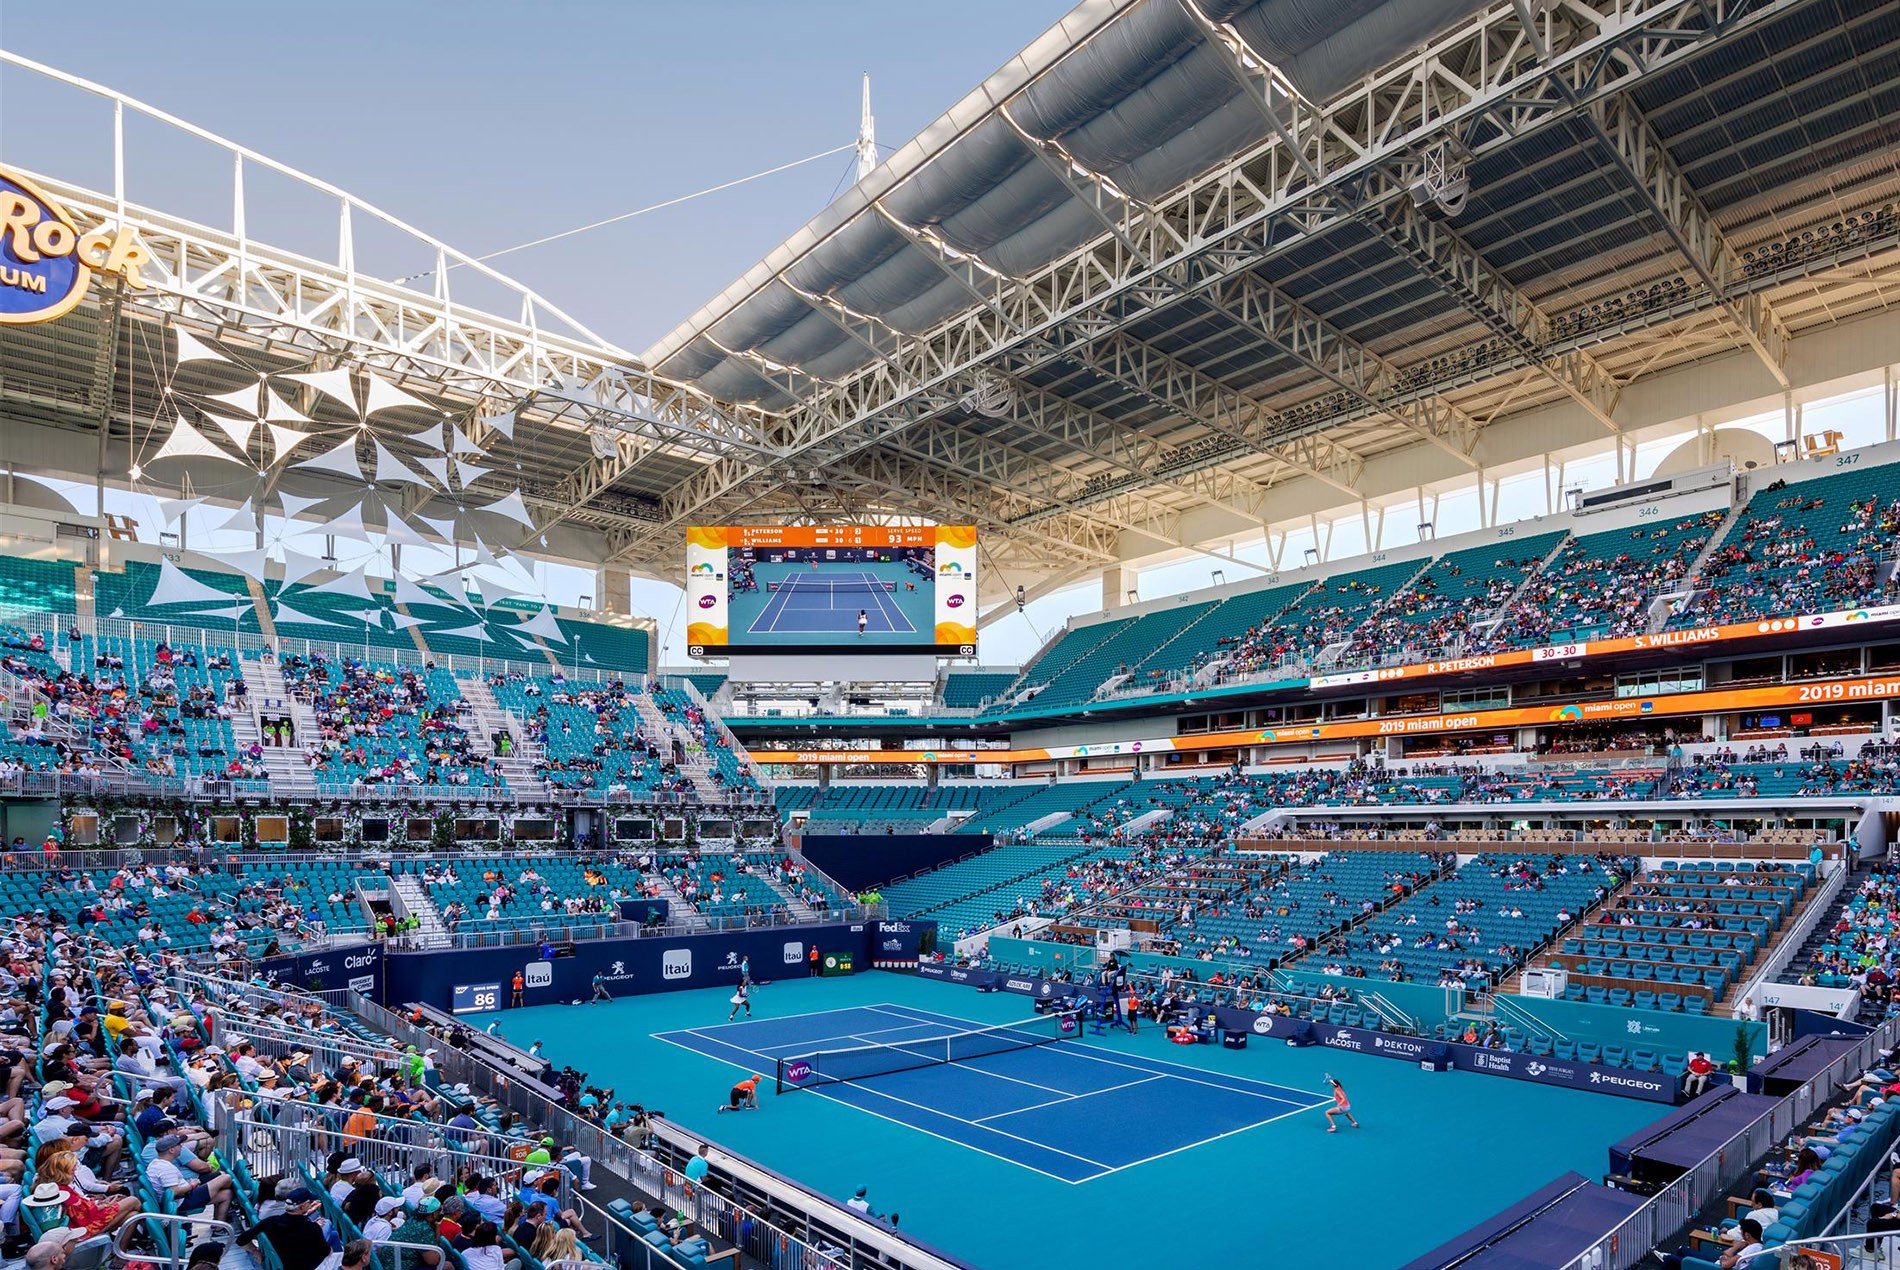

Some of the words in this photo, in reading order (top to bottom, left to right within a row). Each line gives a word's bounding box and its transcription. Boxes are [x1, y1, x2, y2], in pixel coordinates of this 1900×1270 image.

[0, 190, 150, 290] Rock
[1836, 453, 1860, 467] 347
[1638, 507, 1659, 518] 346
[888, 534, 902, 543] 93
[1497, 528, 1515, 538] 345
[1372, 554, 1386, 563] 344
[1634, 636, 1647, 648] S.
[1650, 627, 1719, 646] WILLIAMS
[1542, 648, 1555, 659] 30
[1563, 646, 1577, 655] 30
[1427, 663, 1438, 673] R.
[1439, 656, 1495, 672] PETERSON
[1800, 684, 1844, 700] 2019
[1584, 703, 1612, 713] miami
[1613, 702, 1636, 713] open
[1379, 721, 1405, 733] 2019
[1407, 716, 1444, 731] miami
[1445, 717, 1477, 729] open
[1276, 729, 1294, 737] miami
[818, 753, 846, 761] miami
[847, 754, 870, 763] open
[879, 922, 911, 932] FedEx
[344, 953, 374, 969] Claro
[785, 952, 801, 960] Itaú
[304, 965, 330, 976] LACOSTE
[664, 963, 689, 975] Itaú
[924, 967, 943, 975] PEUGEOT
[527, 973, 550, 984] Itaú
[474, 993, 495, 1006] 86
[1764, 996, 1780, 1004] 147
[1060, 1021, 1076, 1029] WTA
[1325, 1037, 1362, 1050] LACOSTE
[1384, 1039, 1422, 1053] DEKTON
[1489, 1055, 1511, 1064] Baptist
[788, 1065, 811, 1077] WTA
[1488, 1062, 1510, 1071] Health
[1602, 1075, 1662, 1091] PEUGEOT
